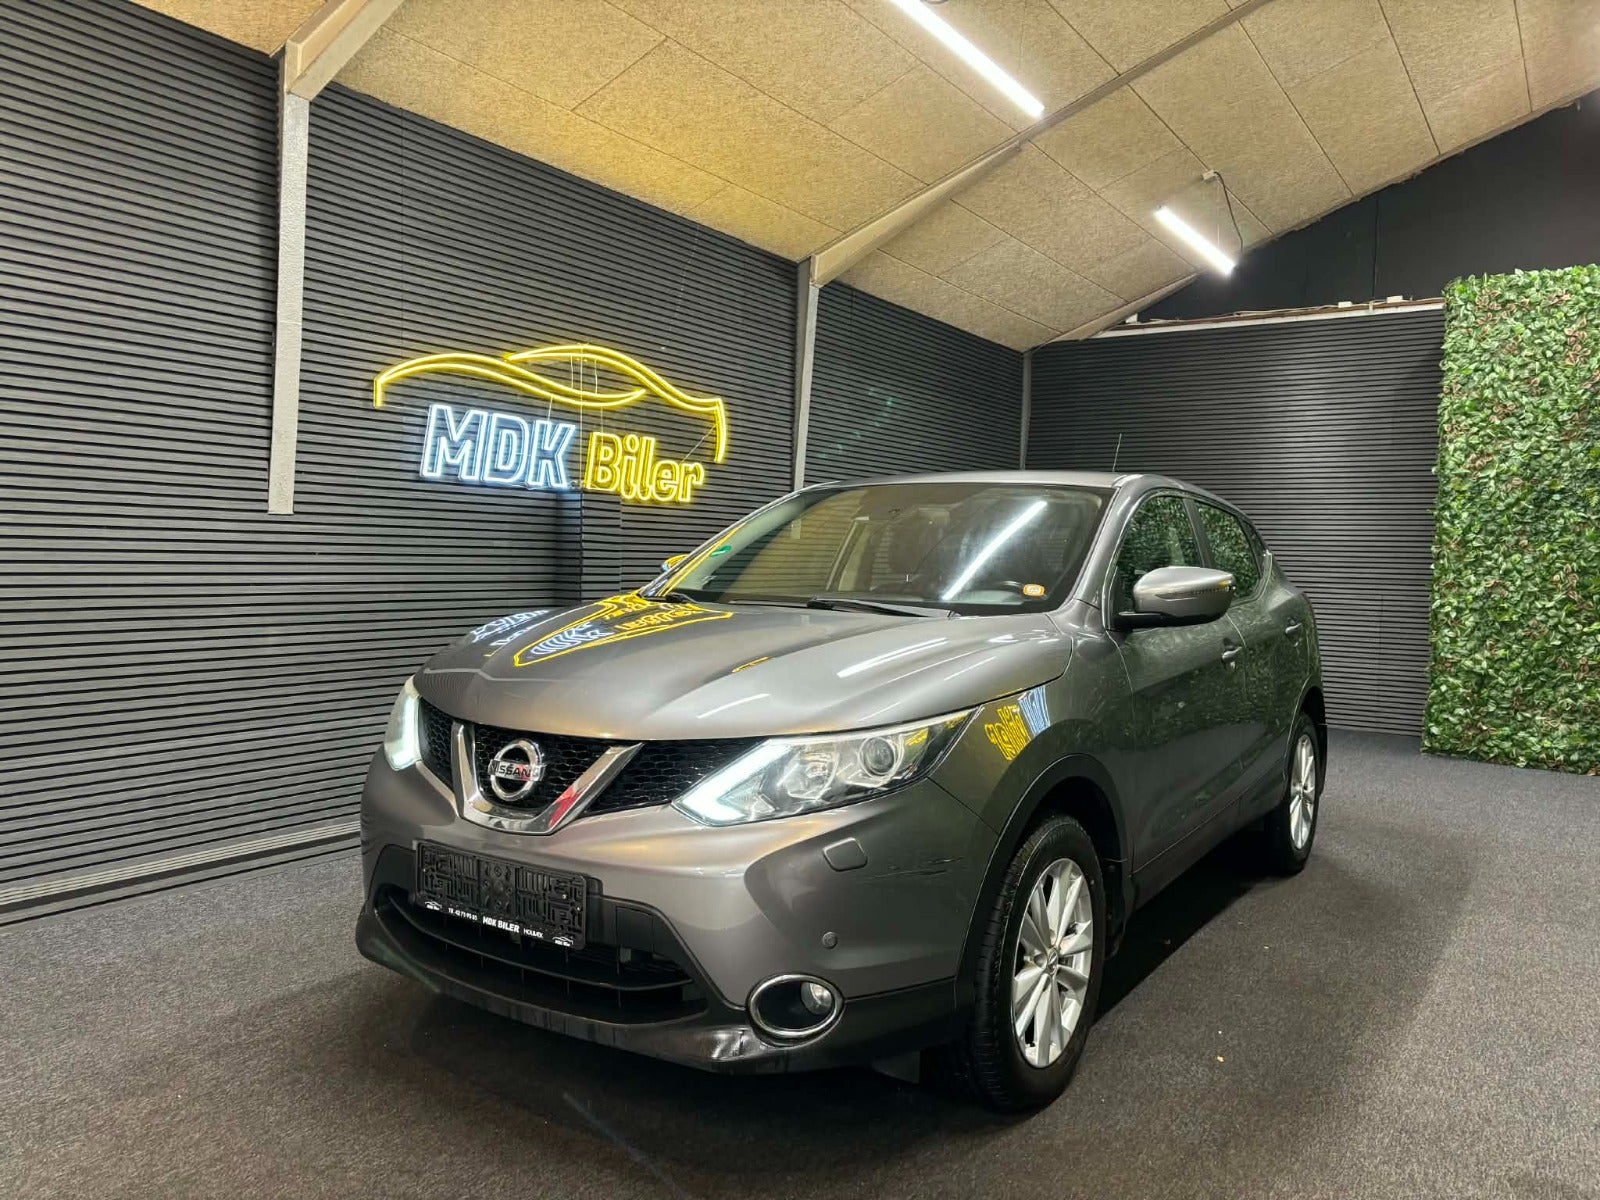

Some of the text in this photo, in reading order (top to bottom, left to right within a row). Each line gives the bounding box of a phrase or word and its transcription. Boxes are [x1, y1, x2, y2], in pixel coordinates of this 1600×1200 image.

[420, 403, 704, 502] MDK Biler
[491, 761, 531, 777] NISSAN
[482, 915, 497, 928] MDK
[497, 919, 520, 934] BILER
